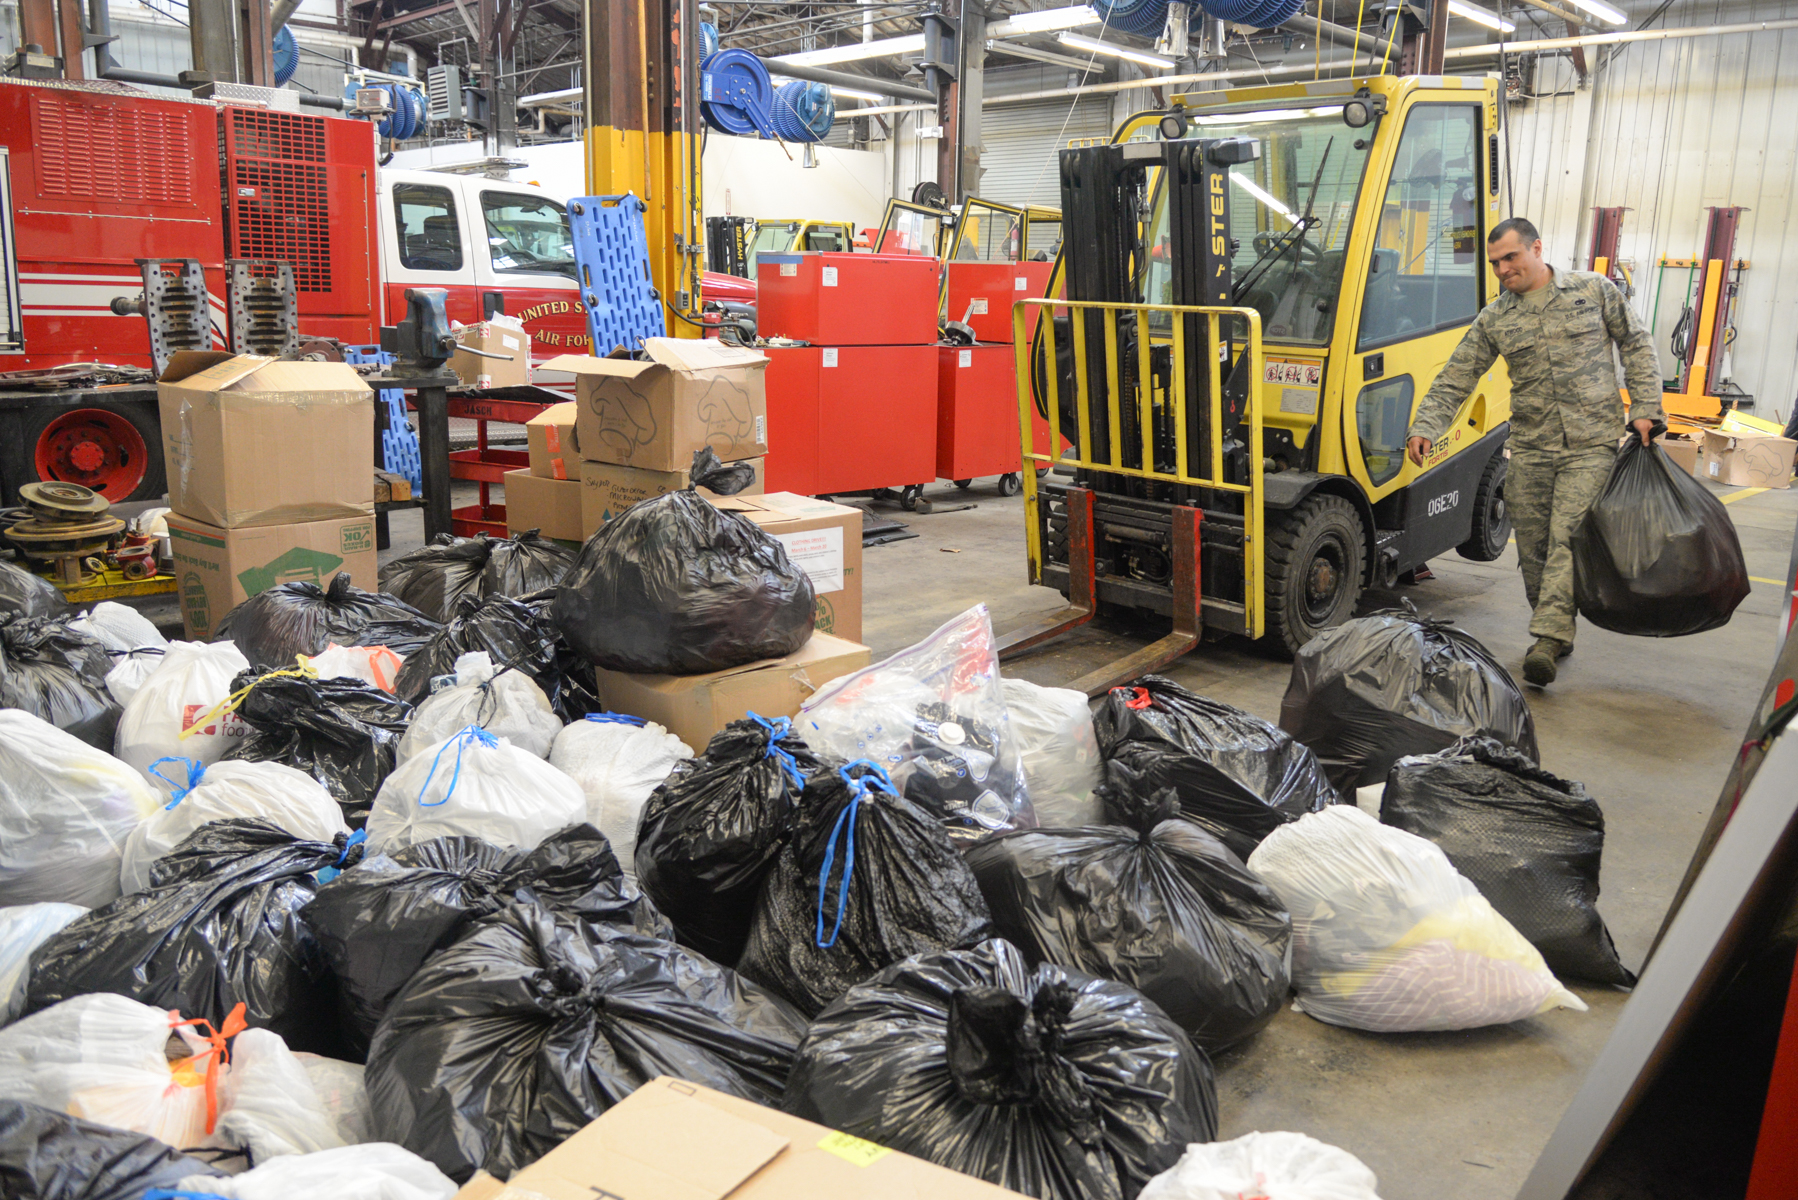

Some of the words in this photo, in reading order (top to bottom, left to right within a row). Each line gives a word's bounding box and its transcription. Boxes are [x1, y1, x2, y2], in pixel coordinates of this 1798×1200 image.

[735, 226, 744, 260] HYSTER
[517, 301, 569, 324] UNITED
[574, 301, 588, 314] S
[534, 329, 560, 347] AIR
[464, 405, 492, 416] JASCH
[1428, 450, 1449, 467] FORTIS
[1428, 490, 1459, 517] 06E20
[344, 532, 361, 542] OK
[815, 615, 832, 629] ACK
